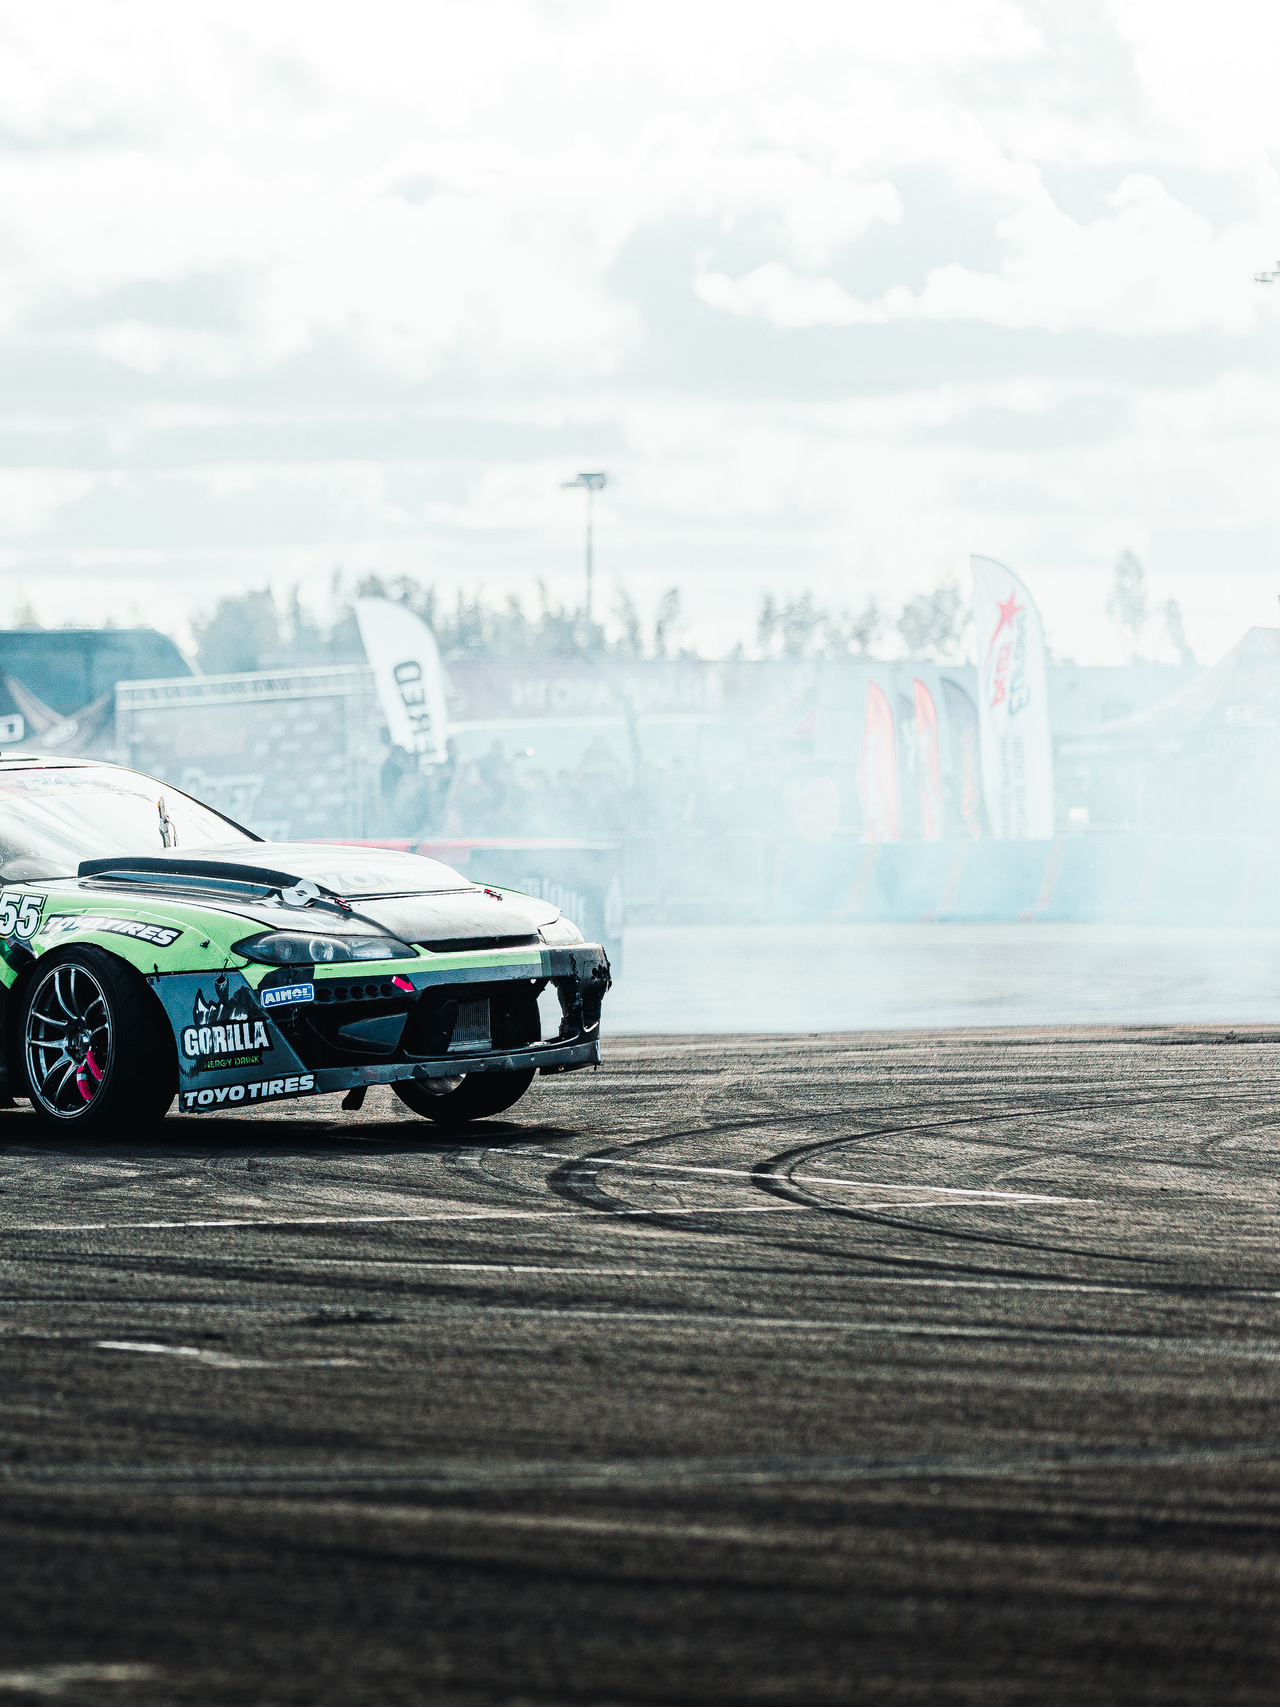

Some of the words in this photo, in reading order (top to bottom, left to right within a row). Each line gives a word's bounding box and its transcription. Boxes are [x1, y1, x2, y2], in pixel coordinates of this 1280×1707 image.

[104, 918, 180, 945] TIRES
[264, 987, 312, 1004] AIMOL
[184, 1020, 270, 1056] GORILLA
[234, 1055, 260, 1065] DRINK
[184, 1085, 246, 1107] TOYO
[248, 1074, 315, 1099] TIRES
